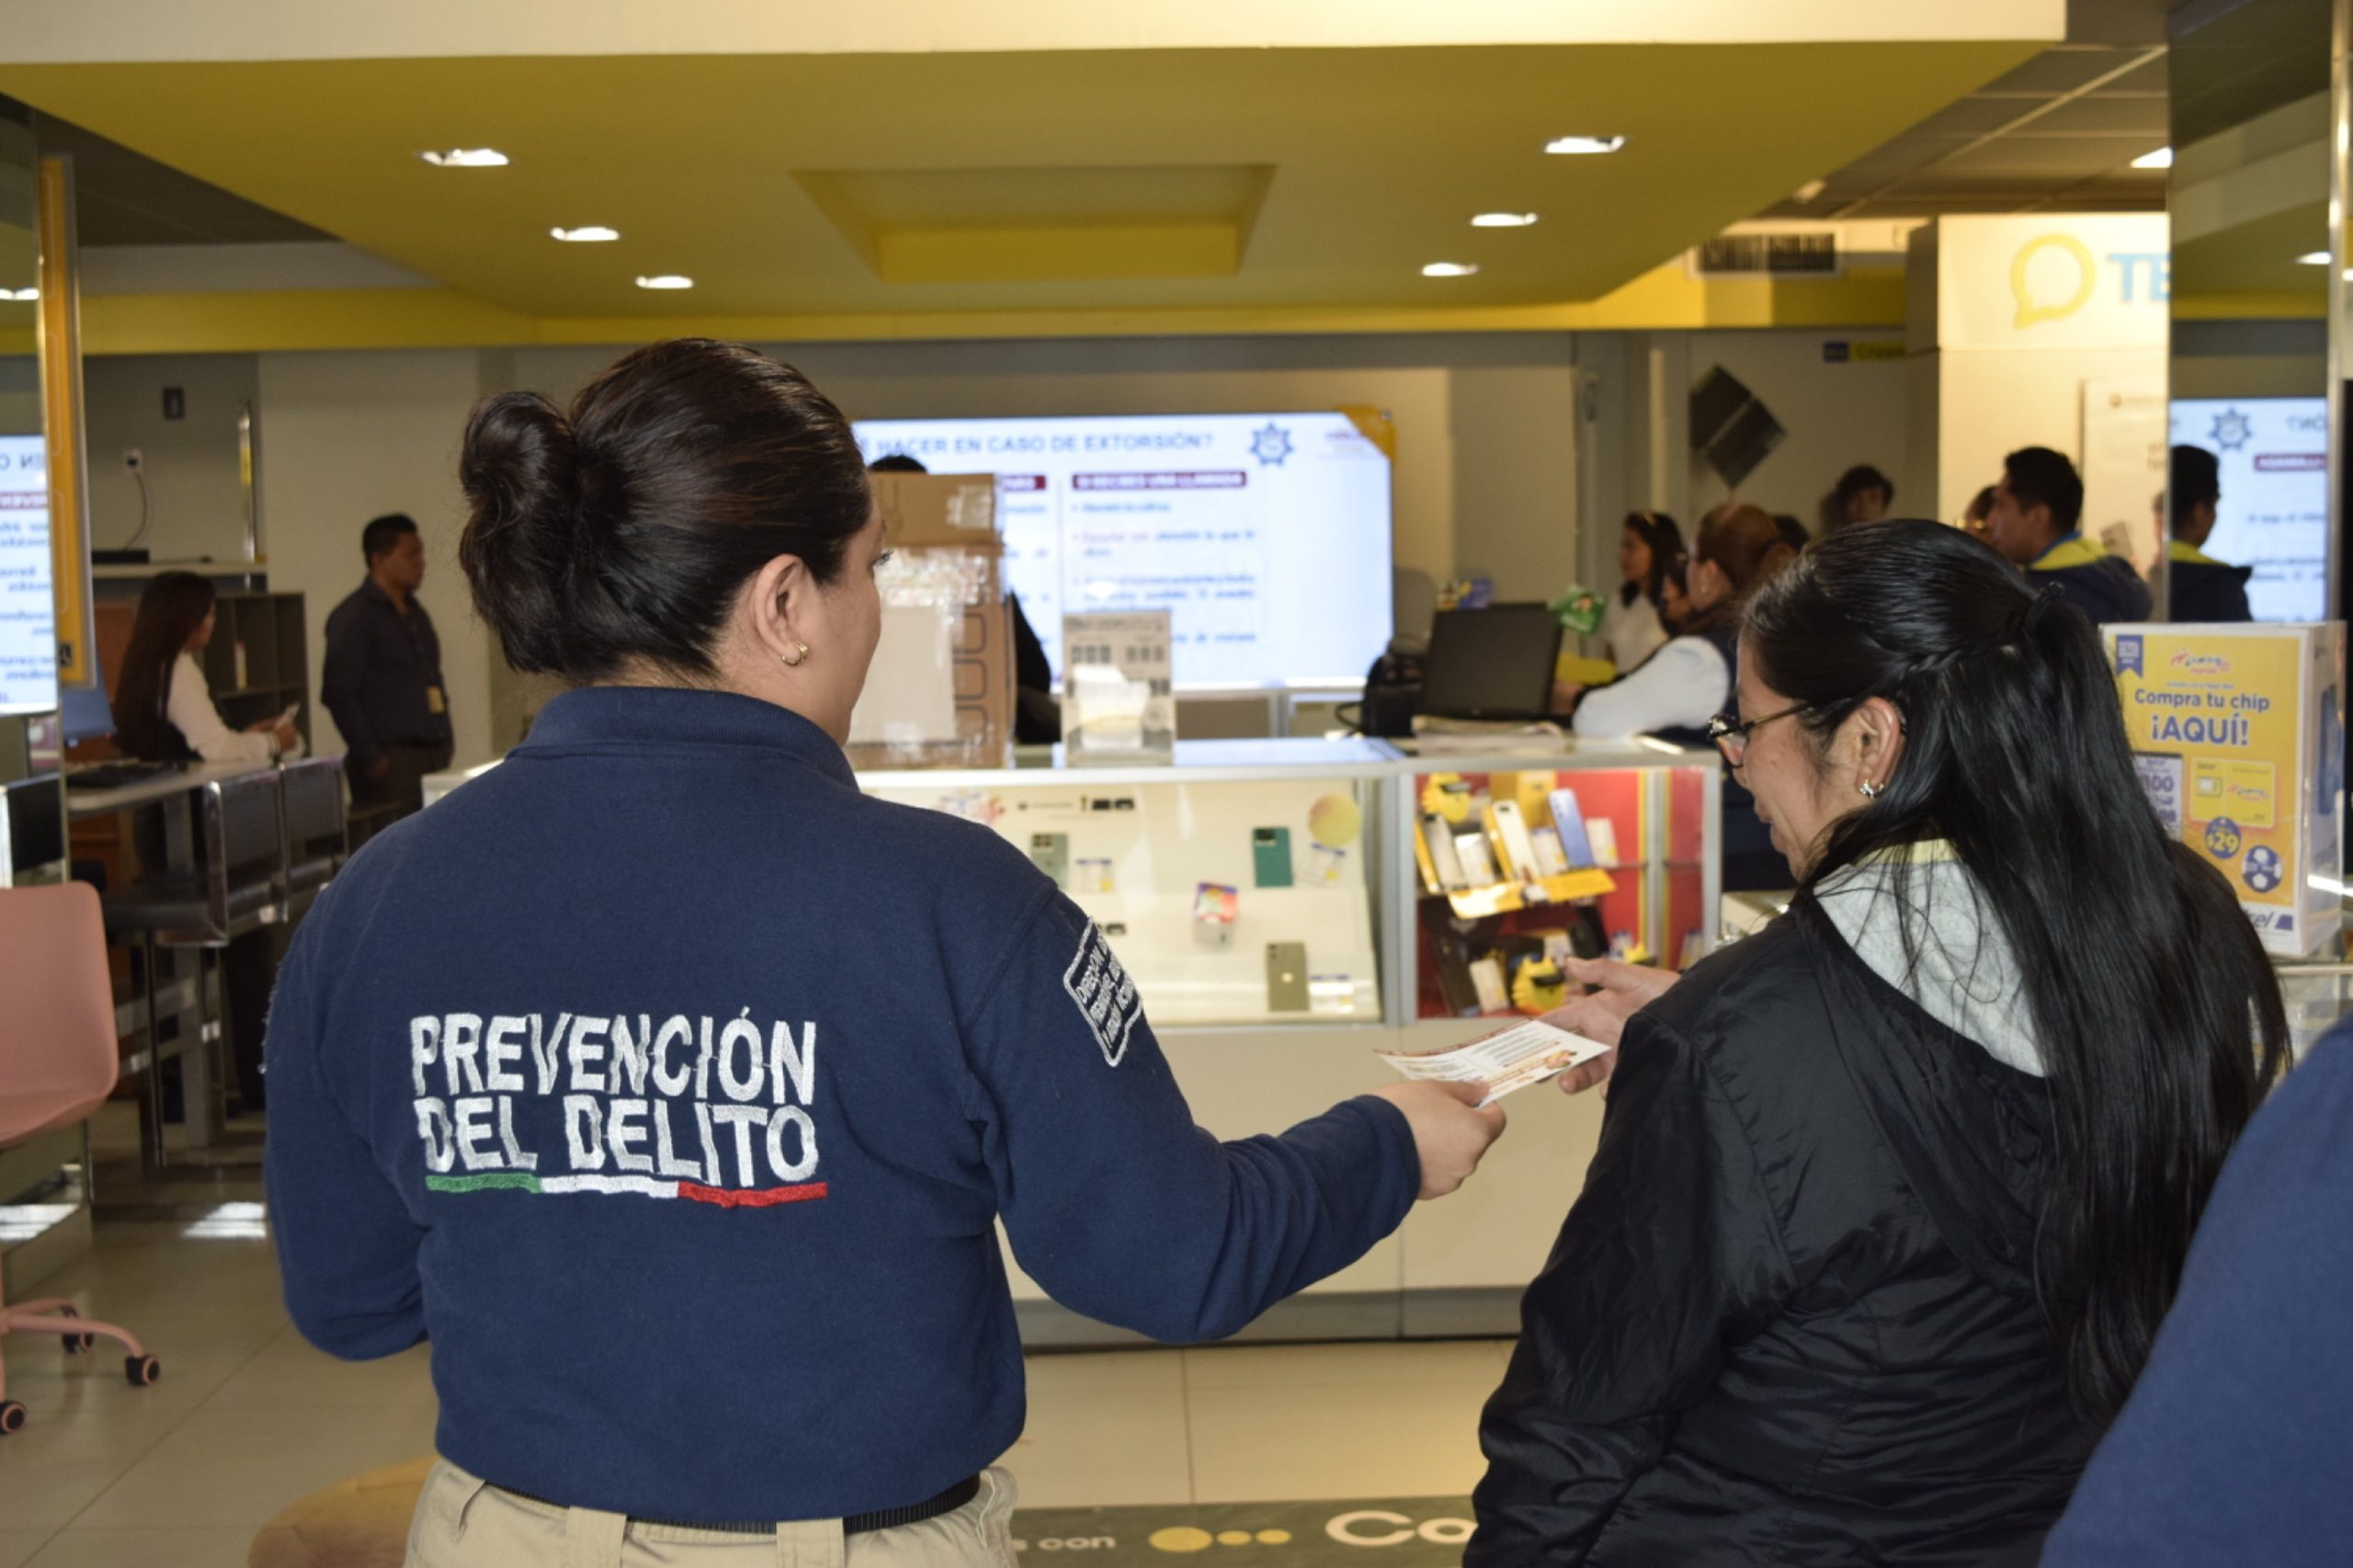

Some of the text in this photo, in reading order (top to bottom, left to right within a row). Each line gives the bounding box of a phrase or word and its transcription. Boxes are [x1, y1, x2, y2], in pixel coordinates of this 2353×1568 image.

[954, 437, 982, 454] EN
[989, 435, 1045, 453] CASO
[1051, 435, 1075, 452] DE
[2134, 688, 2270, 713] Compra tu chip
[2152, 713, 2248, 746] ¡AQUÍ!
[410, 1006, 816, 1106] PREVENCIÓN
[413, 1095, 820, 1187] DEL DELITO
